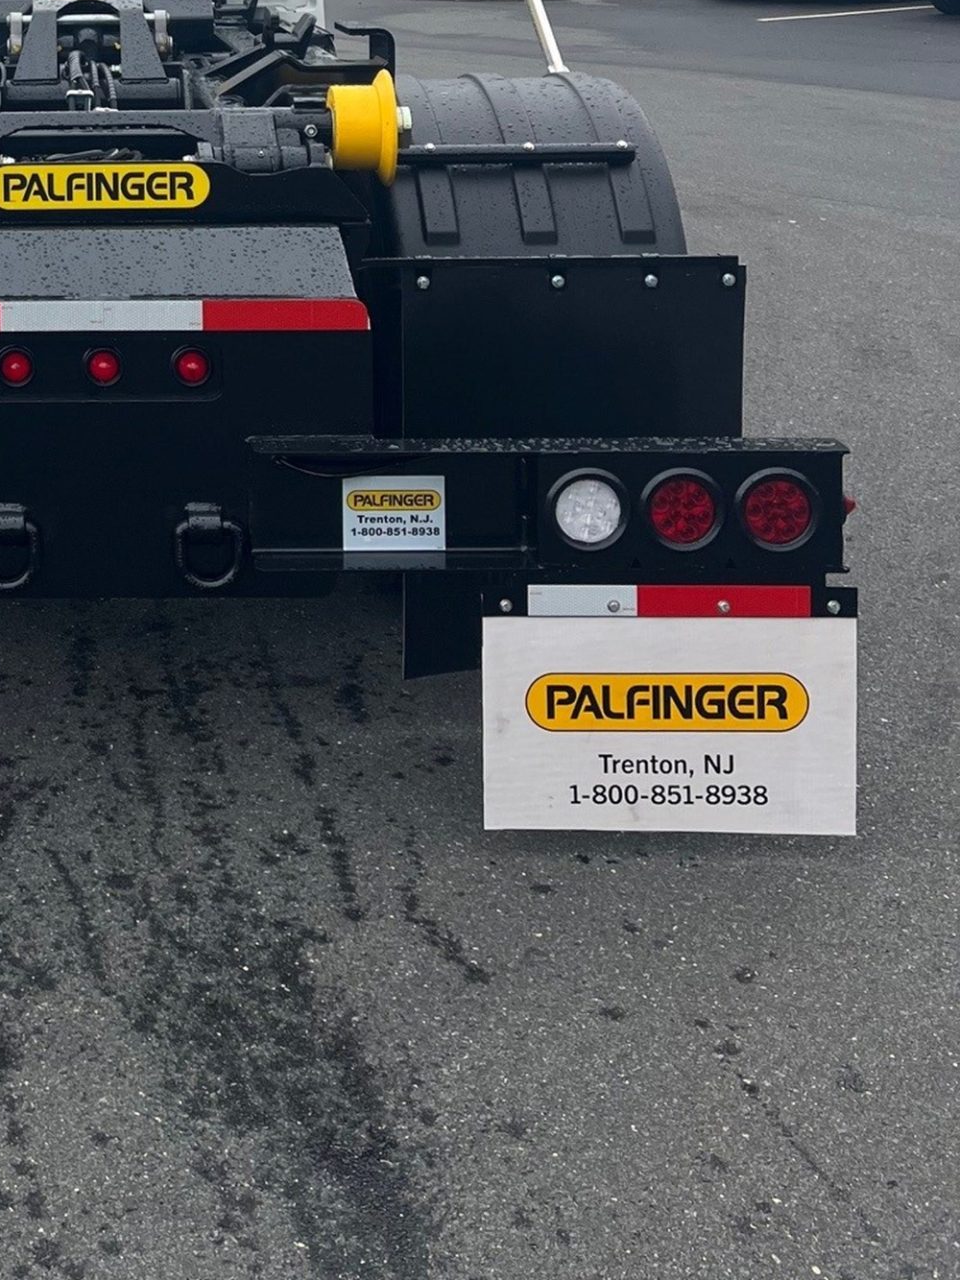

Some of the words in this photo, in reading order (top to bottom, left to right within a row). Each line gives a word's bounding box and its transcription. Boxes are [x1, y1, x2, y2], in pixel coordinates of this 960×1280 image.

[3, 171, 195, 203] PALFINGER
[353, 494, 435, 508] PALFINGER
[357, 515, 407, 525] Trenton,
[410, 514, 434, 524] N.J.
[351, 527, 441, 537] 1-800-851-8938
[546, 684, 788, 720] PALFINGER
[598, 754, 694, 778] Trenton,
[704, 754, 734, 775] NJ
[569, 784, 769, 806] 1-800-851-8938
